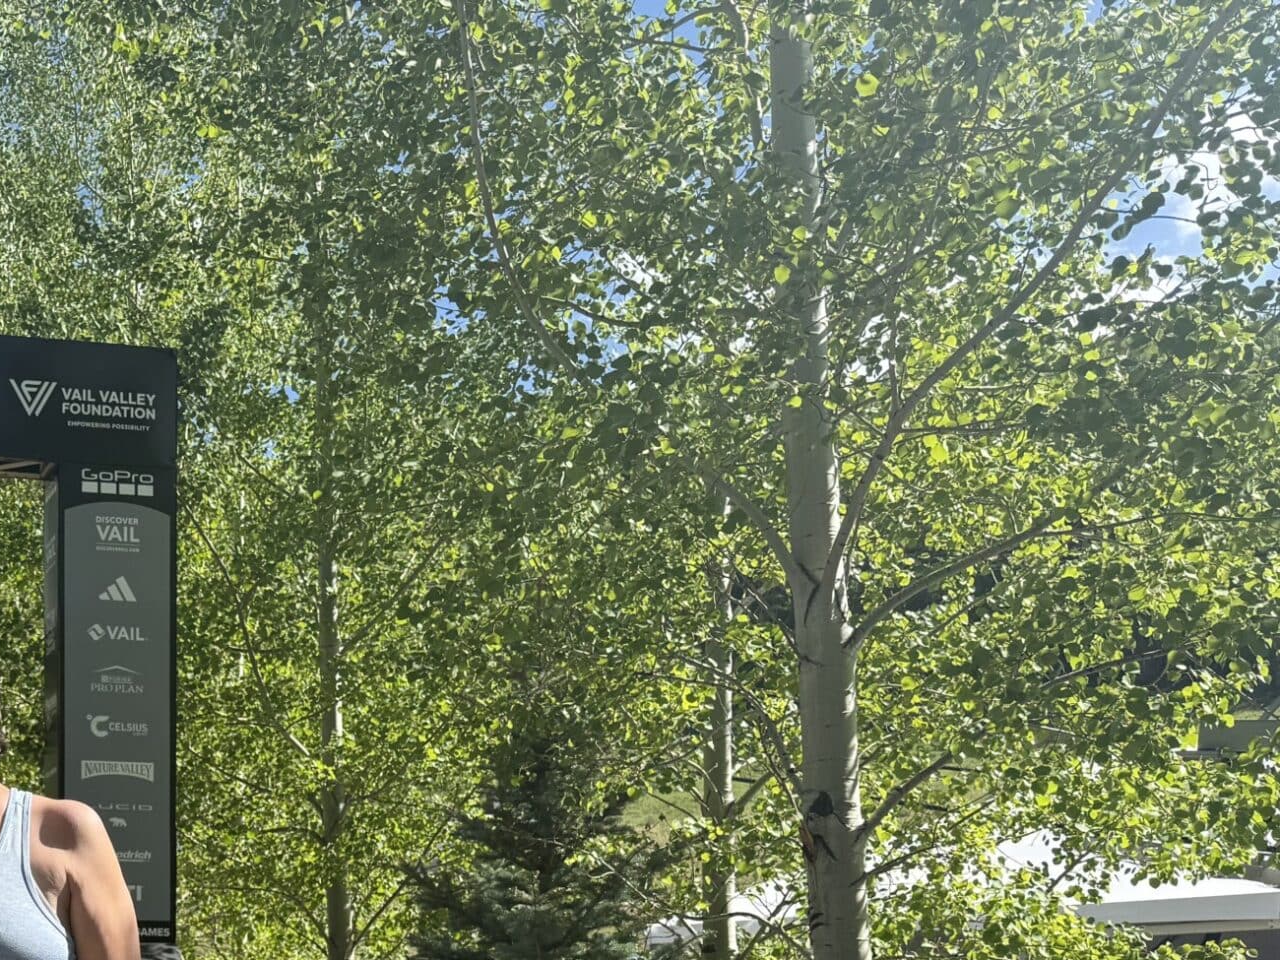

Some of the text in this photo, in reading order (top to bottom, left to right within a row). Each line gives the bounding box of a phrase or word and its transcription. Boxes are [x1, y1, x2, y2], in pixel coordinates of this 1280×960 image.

[61, 387, 156, 407] VAIL VALLEY
[61, 402, 156, 420] FOUNDATION
[67, 420, 150, 432] EMPOWERING POSSIBILITY
[81, 468, 154, 484] GoPro
[96, 515, 139, 525] DISCOVER
[96, 524, 140, 543] VAIL
[106, 625, 146, 641] VAIL
[109, 722, 148, 733] CELSIUS
[139, 926, 170, 937] AMES
